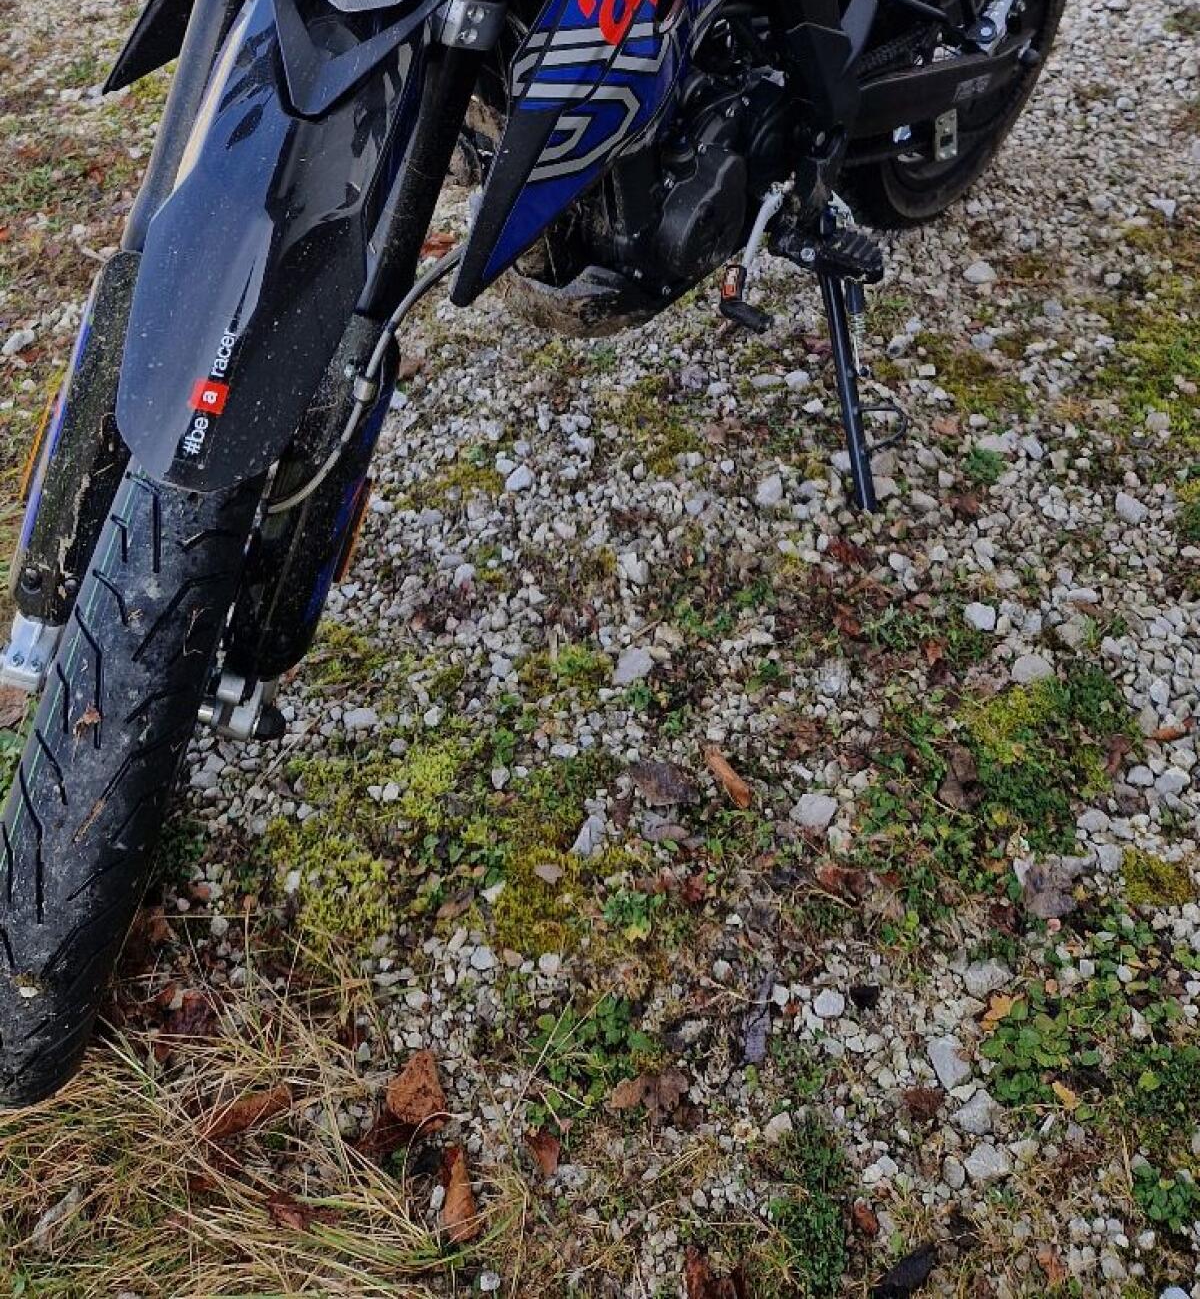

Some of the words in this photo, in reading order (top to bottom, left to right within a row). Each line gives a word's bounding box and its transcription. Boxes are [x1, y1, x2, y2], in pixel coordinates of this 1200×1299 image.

[183, 416, 209, 455] #be
[202, 390, 219, 404] a
[211, 327, 237, 378] racer
